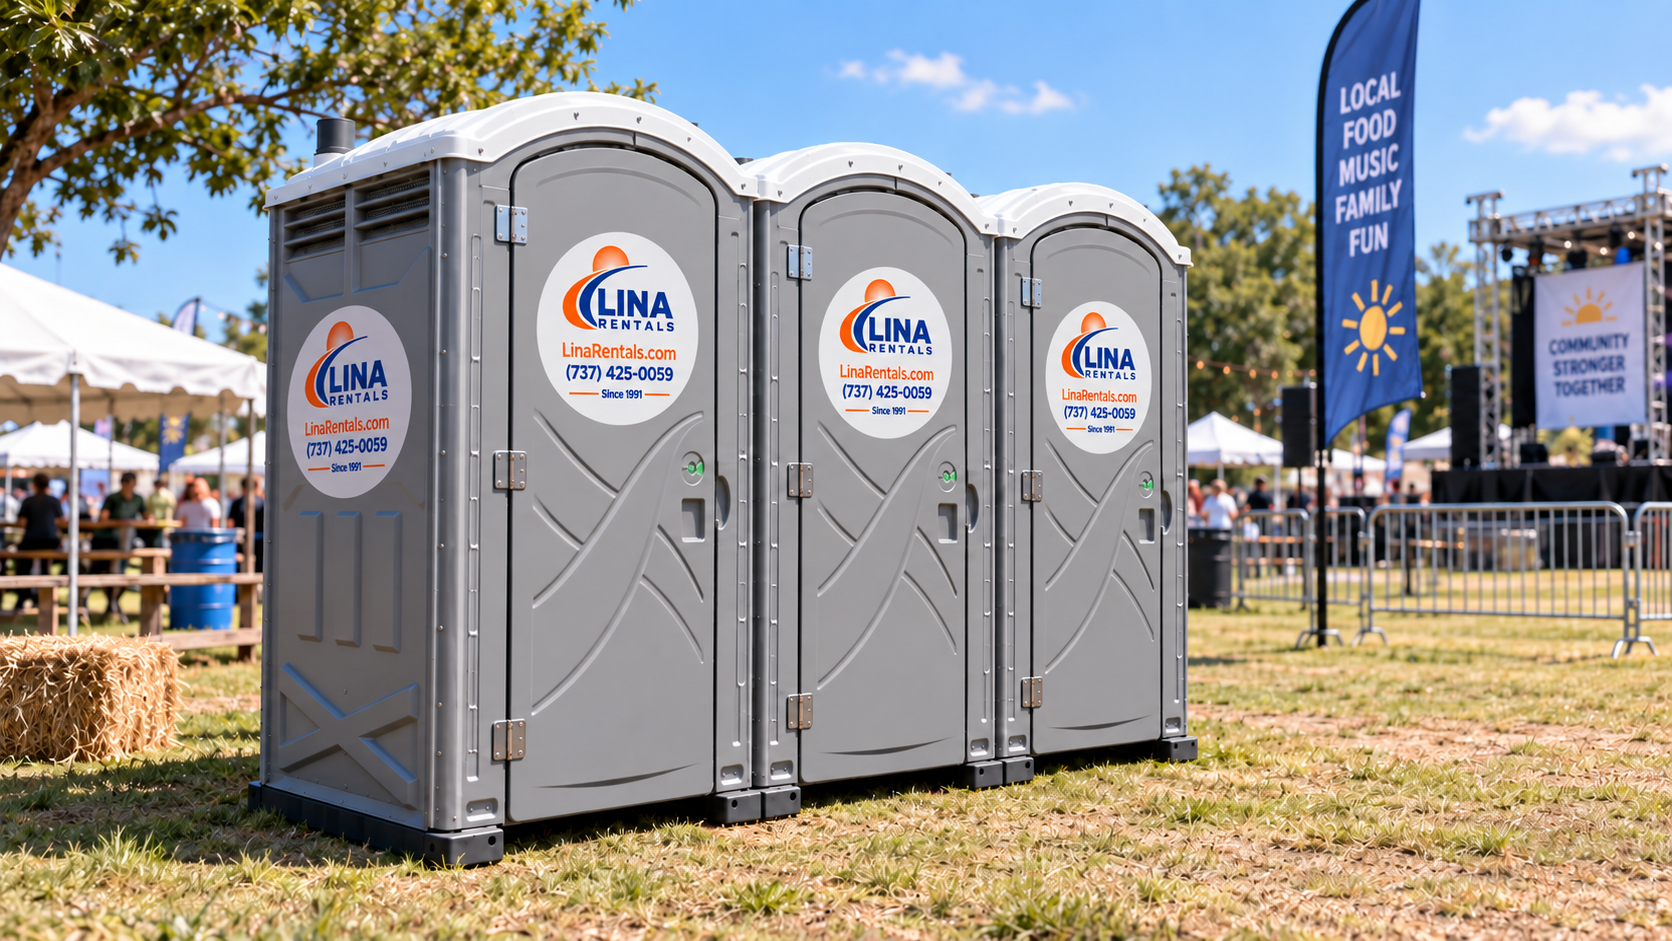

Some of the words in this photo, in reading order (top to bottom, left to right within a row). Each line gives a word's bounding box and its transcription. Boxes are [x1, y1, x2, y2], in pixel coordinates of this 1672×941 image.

[1339, 71, 1402, 115] LOCAL
[1343, 108, 1398, 150] FOOD
[1339, 143, 1400, 187] MUSIC
[1335, 179, 1402, 225] FAMILY
[1349, 222, 1389, 257] FUN
[598, 288, 673, 319] LINA
[598, 318, 675, 332] RENTALS
[869, 316, 931, 343] LINA
[562, 342, 676, 360] LinaRentals.com
[869, 343, 933, 355] RENTALS
[1548, 332, 1630, 355] COMMUNITY
[1085, 346, 1136, 370] LINA
[1553, 355, 1626, 377] STRONGER
[329, 359, 387, 393] LINA
[566, 364, 602, 382] (737)
[605, 365, 674, 382] 425-0059
[840, 364, 934, 381] LinaRentals.com
[1085, 369, 1136, 381] RENTALS
[601, 389, 624, 399] Since
[625, 389, 643, 399] 1991
[842, 383, 873, 400] (737)
[876, 385, 933, 399] 425-0059
[1062, 388, 1137, 403] LinaRentals.com
[1553, 376, 1626, 397] TOGETHER
[330, 389, 388, 406] RENTALS
[871, 406, 891, 415] Since
[892, 406, 907, 415] 1991
[1064, 405, 1088, 420] (737)
[1090, 406, 1136, 420] 425-0059
[305, 416, 390, 437] LinaRentals.com
[1087, 425, 1103, 433] Since
[306, 441, 332, 459] (737)
[335, 436, 388, 455] 425-0059
[331, 463, 348, 473] Since
[348, 462, 362, 472] 1991
